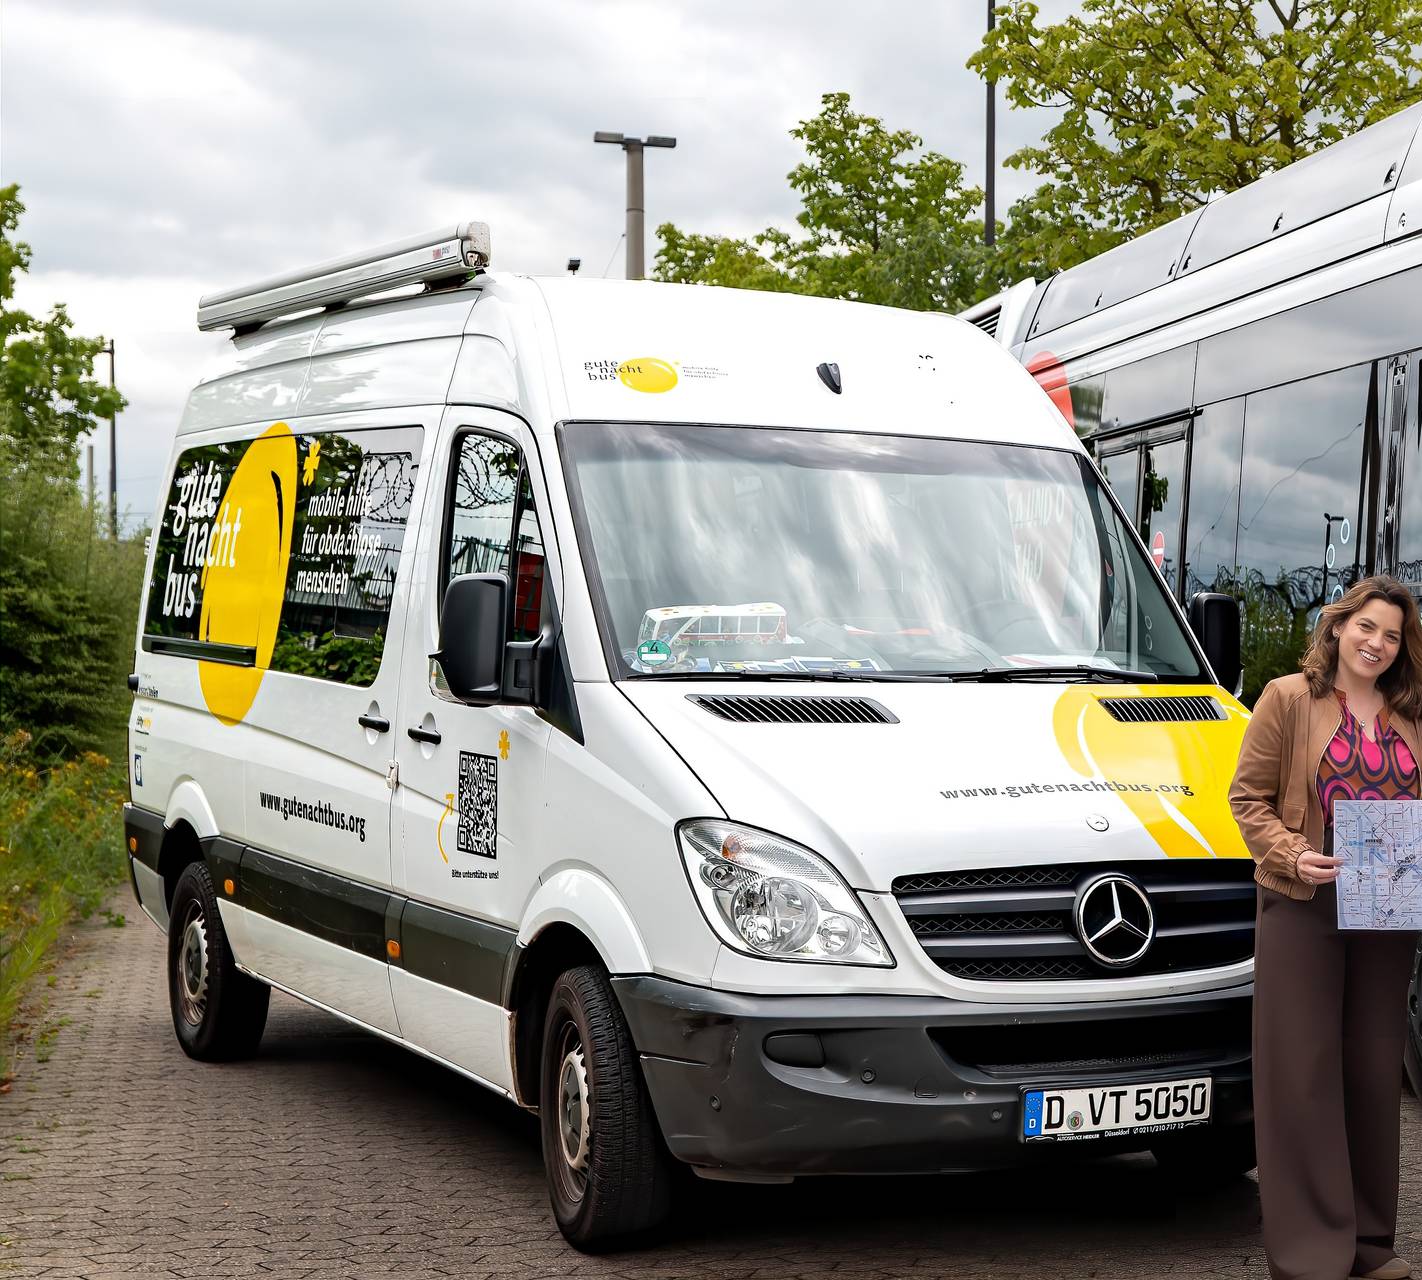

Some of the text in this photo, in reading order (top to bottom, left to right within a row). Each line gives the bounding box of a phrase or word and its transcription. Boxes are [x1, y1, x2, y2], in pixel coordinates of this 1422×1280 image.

[583, 359, 618, 371] gute
[588, 372, 617, 382] bus
[600, 364, 643, 375] nacht
[173, 461, 222, 537] gute
[307, 486, 373, 517] mobile hilfe
[183, 502, 242, 568] nacht
[301, 524, 382, 556] für obdachlose
[163, 553, 199, 619] bus
[295, 563, 349, 595] menschen
[650, 641, 659, 654] 4
[939, 780, 1195, 799] www.gutenachtbus.org
[259, 791, 366, 843] www.gutenachtbus.org
[1044, 1082, 1207, 1130] D VT 5050
[1028, 1118, 1037, 1129] D
[1104, 1128, 1130, 1138] Düsseldorf
